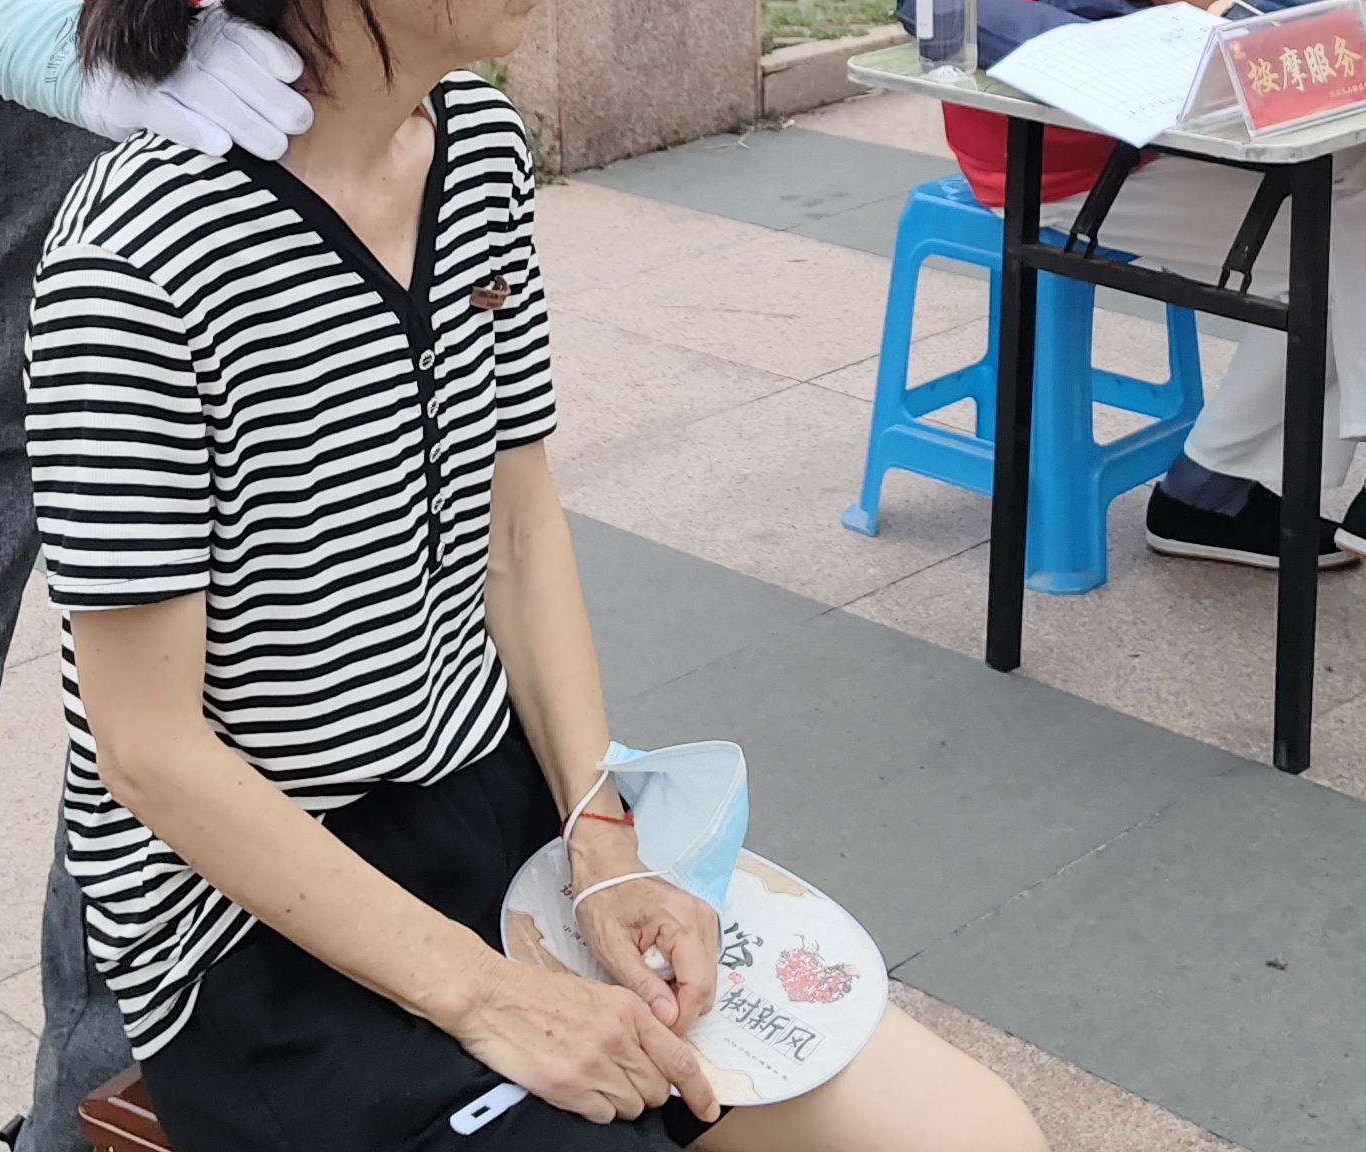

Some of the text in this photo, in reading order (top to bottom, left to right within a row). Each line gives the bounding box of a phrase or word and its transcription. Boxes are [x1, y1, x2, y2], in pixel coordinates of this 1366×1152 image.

[1247, 36, 1362, 96] 按摩服务
[720, 988, 817, 1062] 树新风
